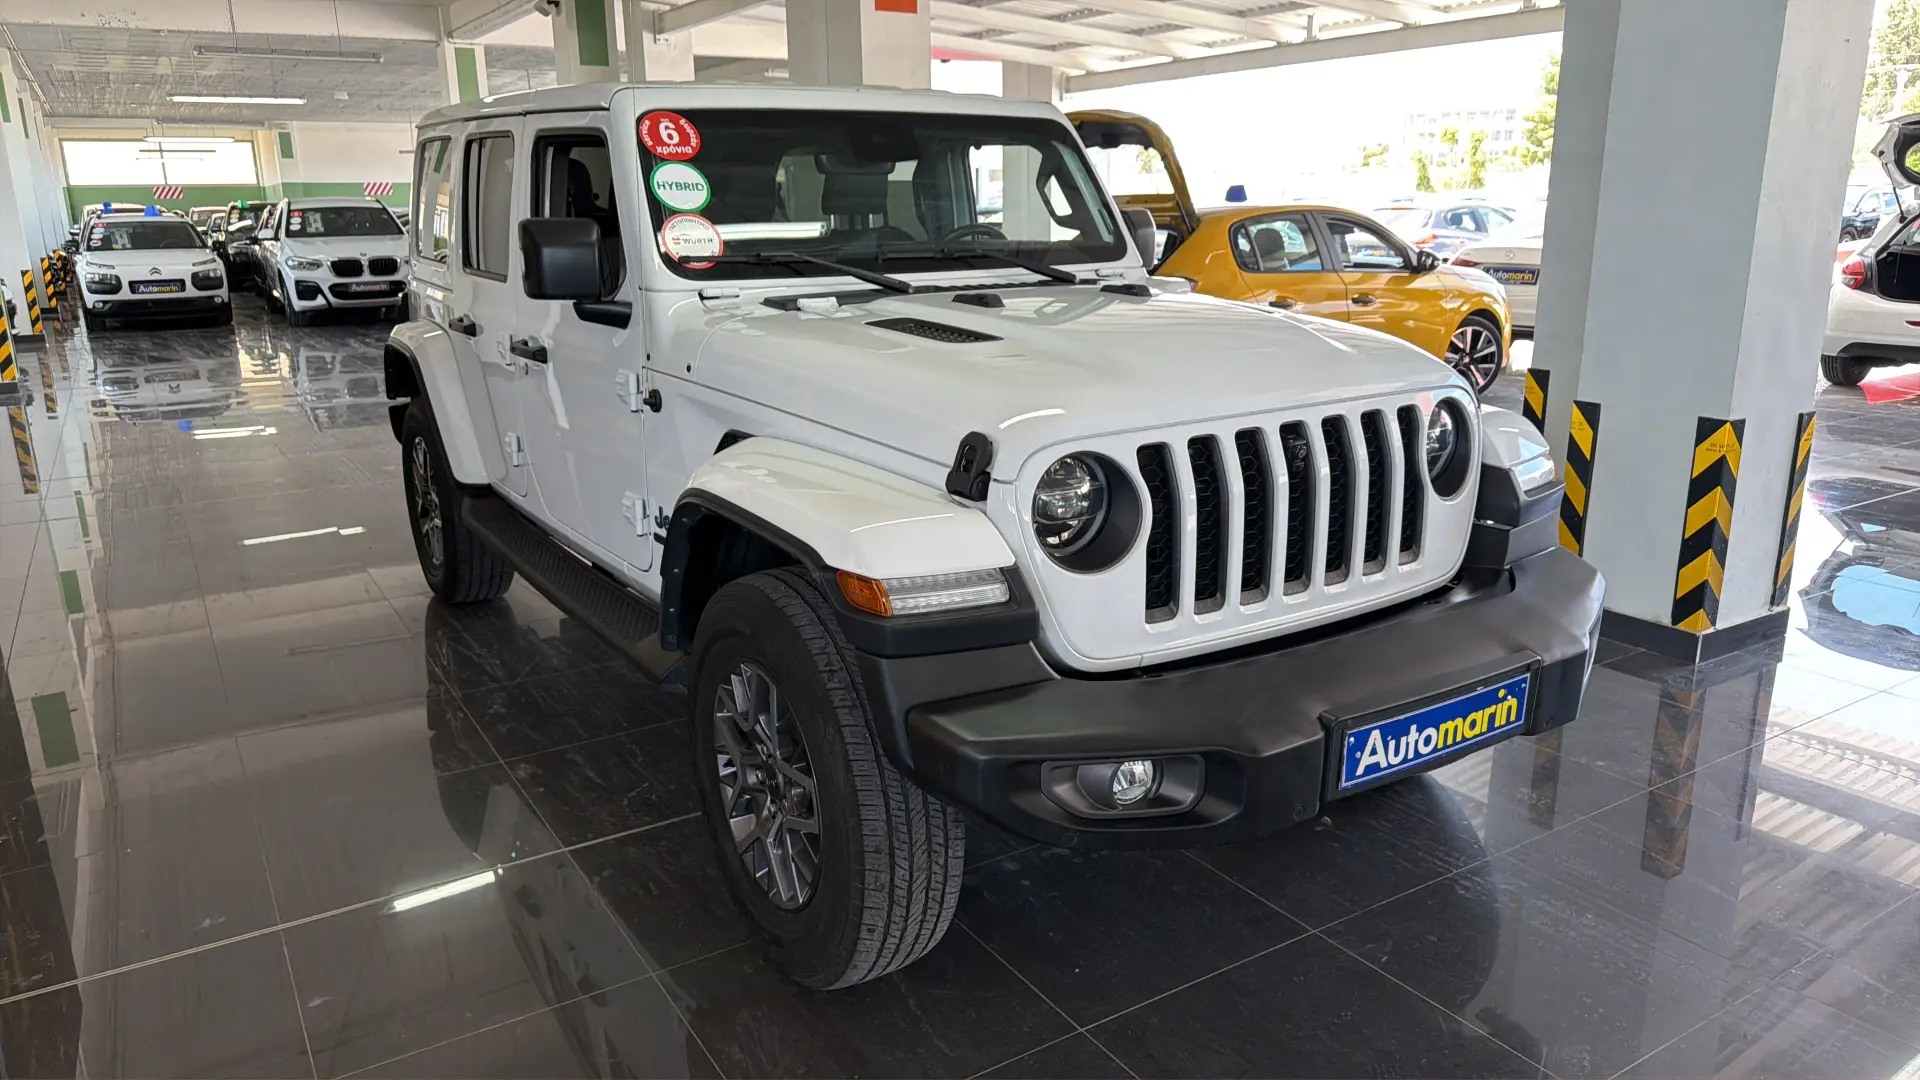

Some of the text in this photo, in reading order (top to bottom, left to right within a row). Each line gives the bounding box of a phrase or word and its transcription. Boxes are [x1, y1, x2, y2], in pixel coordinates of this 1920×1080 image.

[658, 121, 680, 145] 6
[655, 143, 693, 155] χρόνια
[656, 180, 705, 192] HYBRID
[1355, 688, 1518, 776] Automarin
